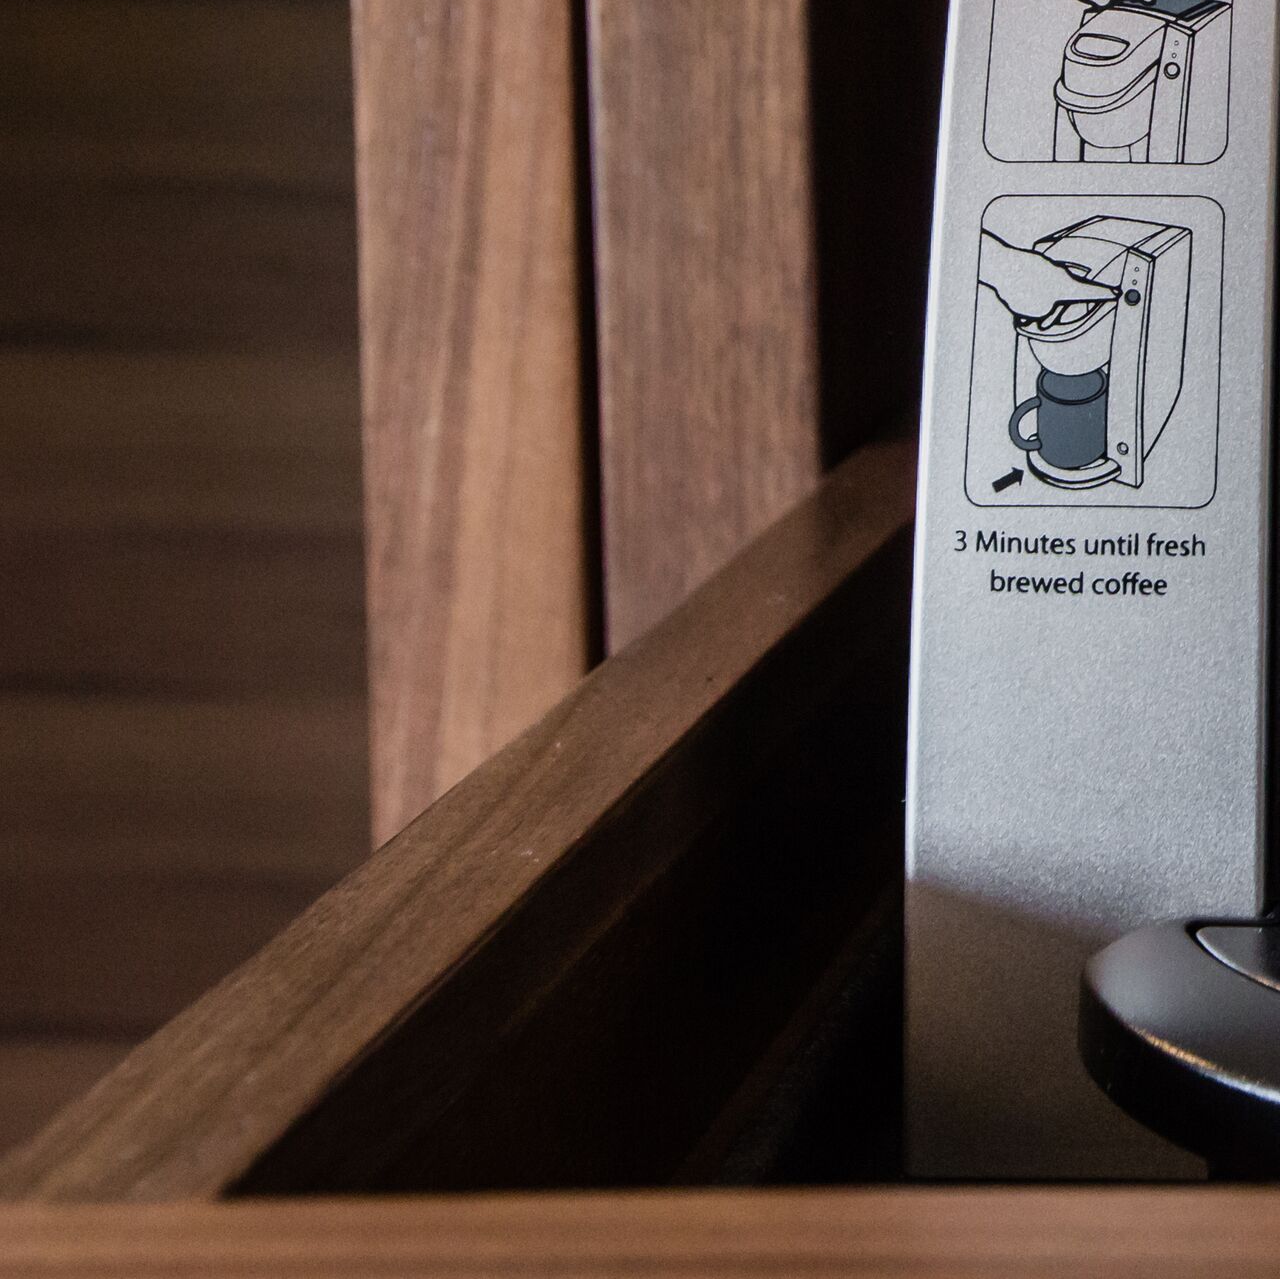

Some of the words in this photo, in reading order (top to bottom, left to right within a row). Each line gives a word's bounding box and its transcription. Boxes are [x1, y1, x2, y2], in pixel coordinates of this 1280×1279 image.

[953, 529, 968, 552] 3
[975, 529, 1077, 555] Minutes
[1084, 533, 1140, 557] until
[1146, 532, 1207, 557] fresh
[989, 568, 1085, 595] brewed
[1091, 571, 1169, 596] coffee
